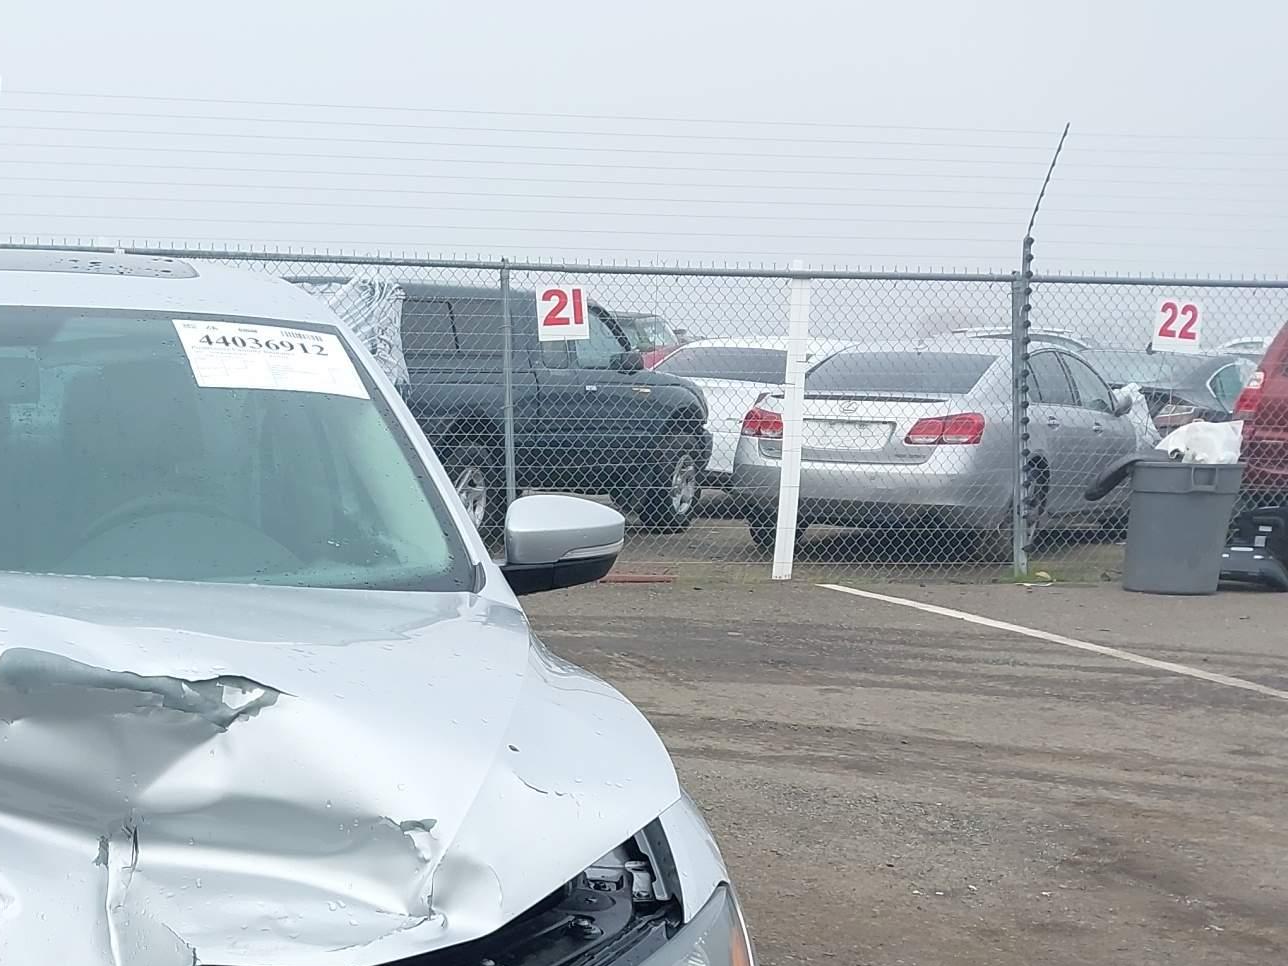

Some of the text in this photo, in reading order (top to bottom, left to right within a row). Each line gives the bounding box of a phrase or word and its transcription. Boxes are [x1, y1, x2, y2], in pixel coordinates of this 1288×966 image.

[542, 288, 584, 326] 21
[1158, 302, 1198, 340] 22
[198, 333, 329, 357] 44036912
